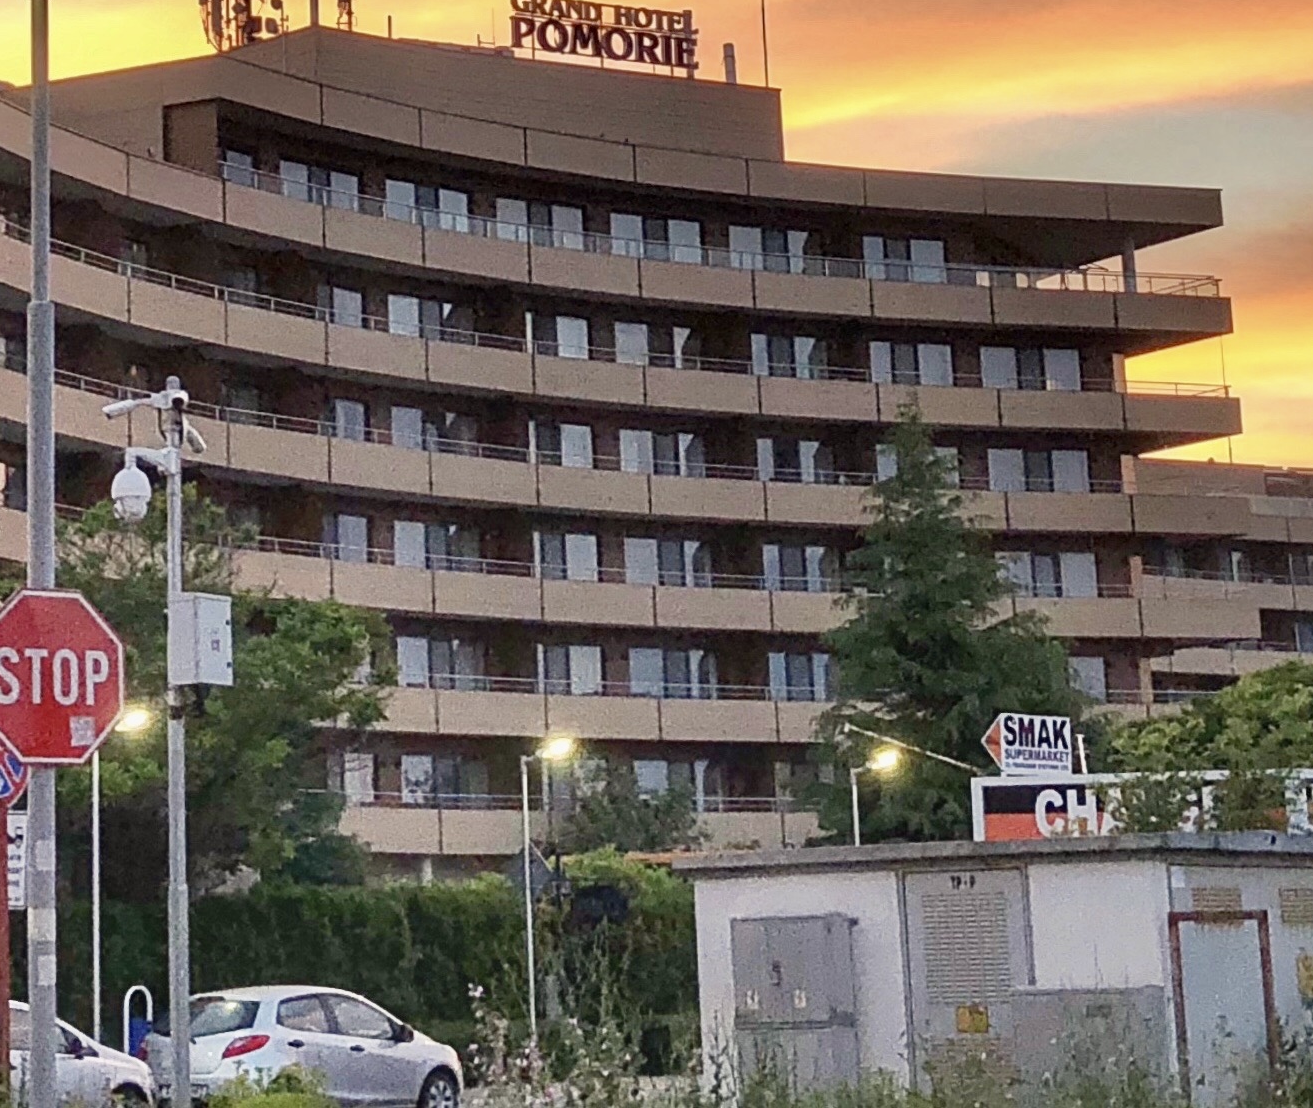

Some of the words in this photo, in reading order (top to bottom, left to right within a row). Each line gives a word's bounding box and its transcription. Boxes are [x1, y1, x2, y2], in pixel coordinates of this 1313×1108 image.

[613, 4, 698, 34] HOTEL
[509, 15, 699, 70] POMORIE
[1003, 714, 1069, 750] SMAK
[1004, 748, 1070, 763] SUPERMARKET
